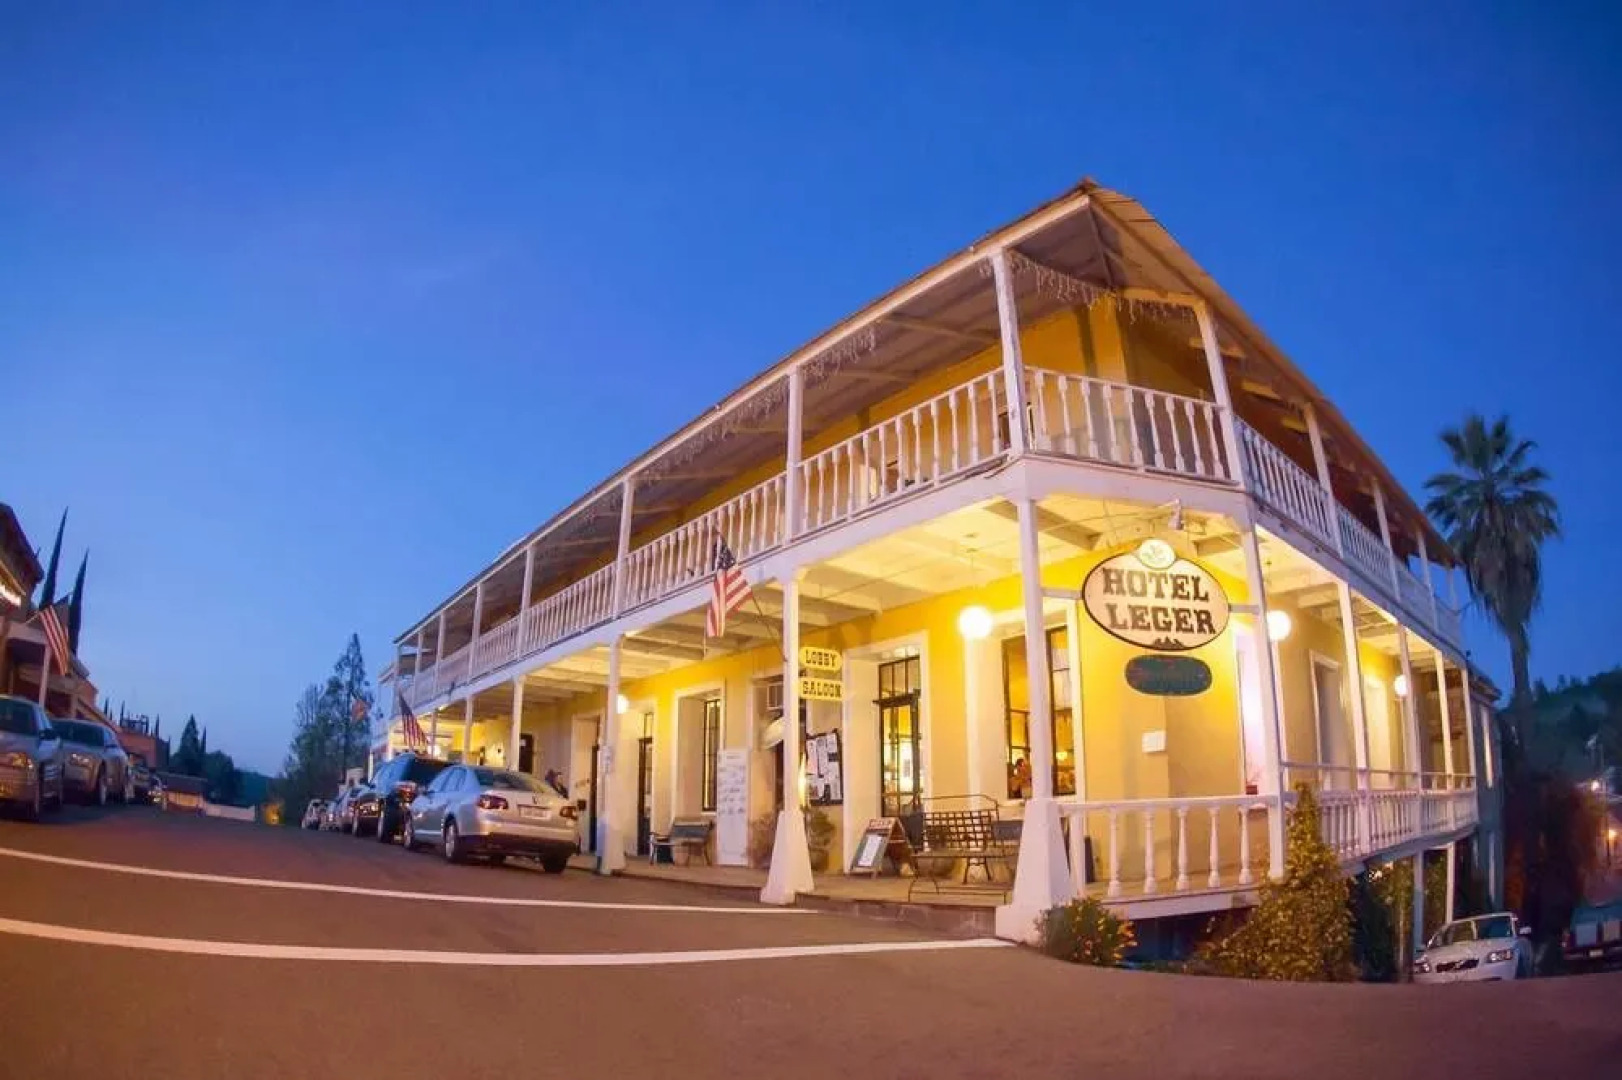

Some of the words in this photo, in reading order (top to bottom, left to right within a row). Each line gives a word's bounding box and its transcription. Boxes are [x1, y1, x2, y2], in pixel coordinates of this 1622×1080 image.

[1102, 567, 1209, 603] HOTEL
[1106, 603, 1216, 635] LEGER
[805, 649, 837, 667] LOBBY
[802, 680, 841, 698] SALOON
